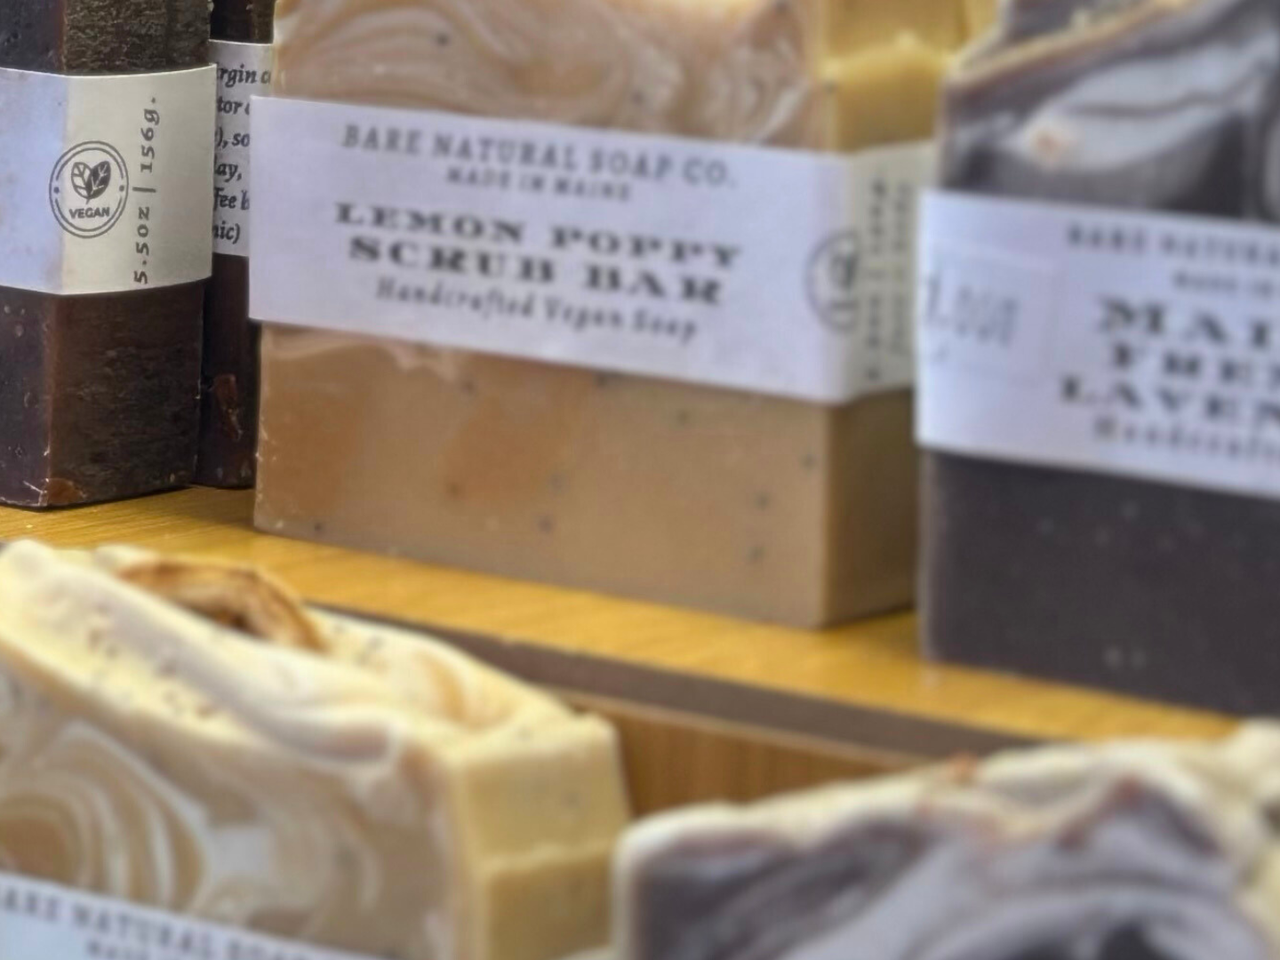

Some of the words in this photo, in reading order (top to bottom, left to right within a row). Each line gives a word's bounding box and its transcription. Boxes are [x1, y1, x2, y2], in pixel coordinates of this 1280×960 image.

[140, 96, 161, 174] 156g.
[342, 124, 421, 157] BARE
[432, 132, 577, 172] NATURAL
[589, 148, 674, 183] SOAP
[682, 159, 736, 189] CO.
[68, 206, 111, 220] VEGAN
[134, 205, 151, 285] 5.5oz
[335, 200, 526, 248] LEMON
[549, 227, 741, 271] POPPY
[348, 236, 556, 285] SCRUB
[586, 268, 723, 307] BAR
[376, 275, 535, 322] Handcrafted
[544, 297, 624, 333] Vegan
[633, 307, 698, 345] Soap
